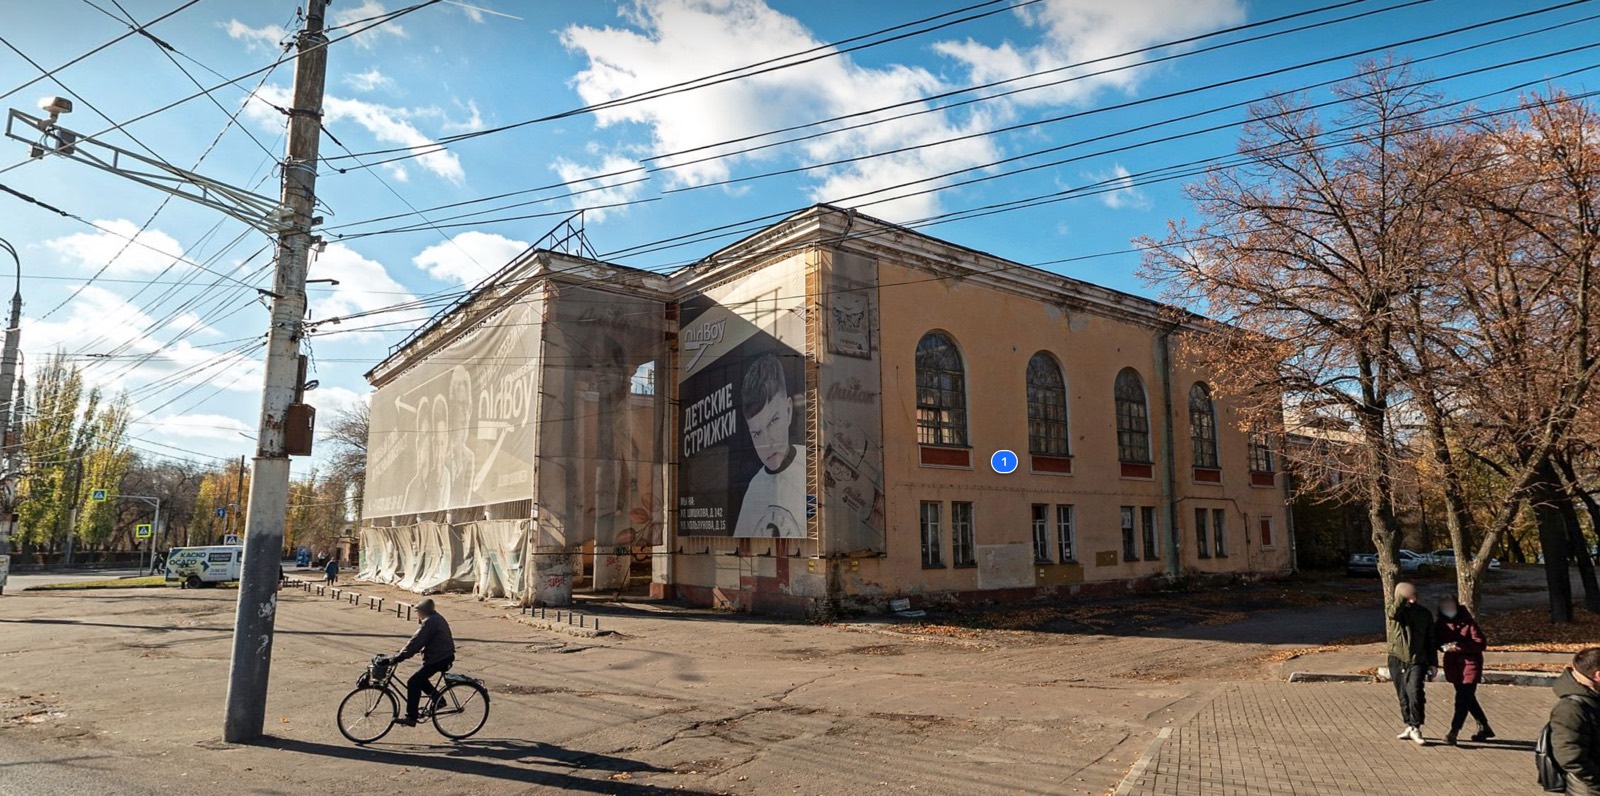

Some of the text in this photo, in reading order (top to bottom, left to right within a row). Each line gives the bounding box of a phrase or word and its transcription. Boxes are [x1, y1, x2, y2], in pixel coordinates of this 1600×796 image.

[684, 382, 733, 434] ДЕТСКИЕ
[684, 409, 737, 458] СТРИЖКИ
[721, 520, 726, 530] 15
